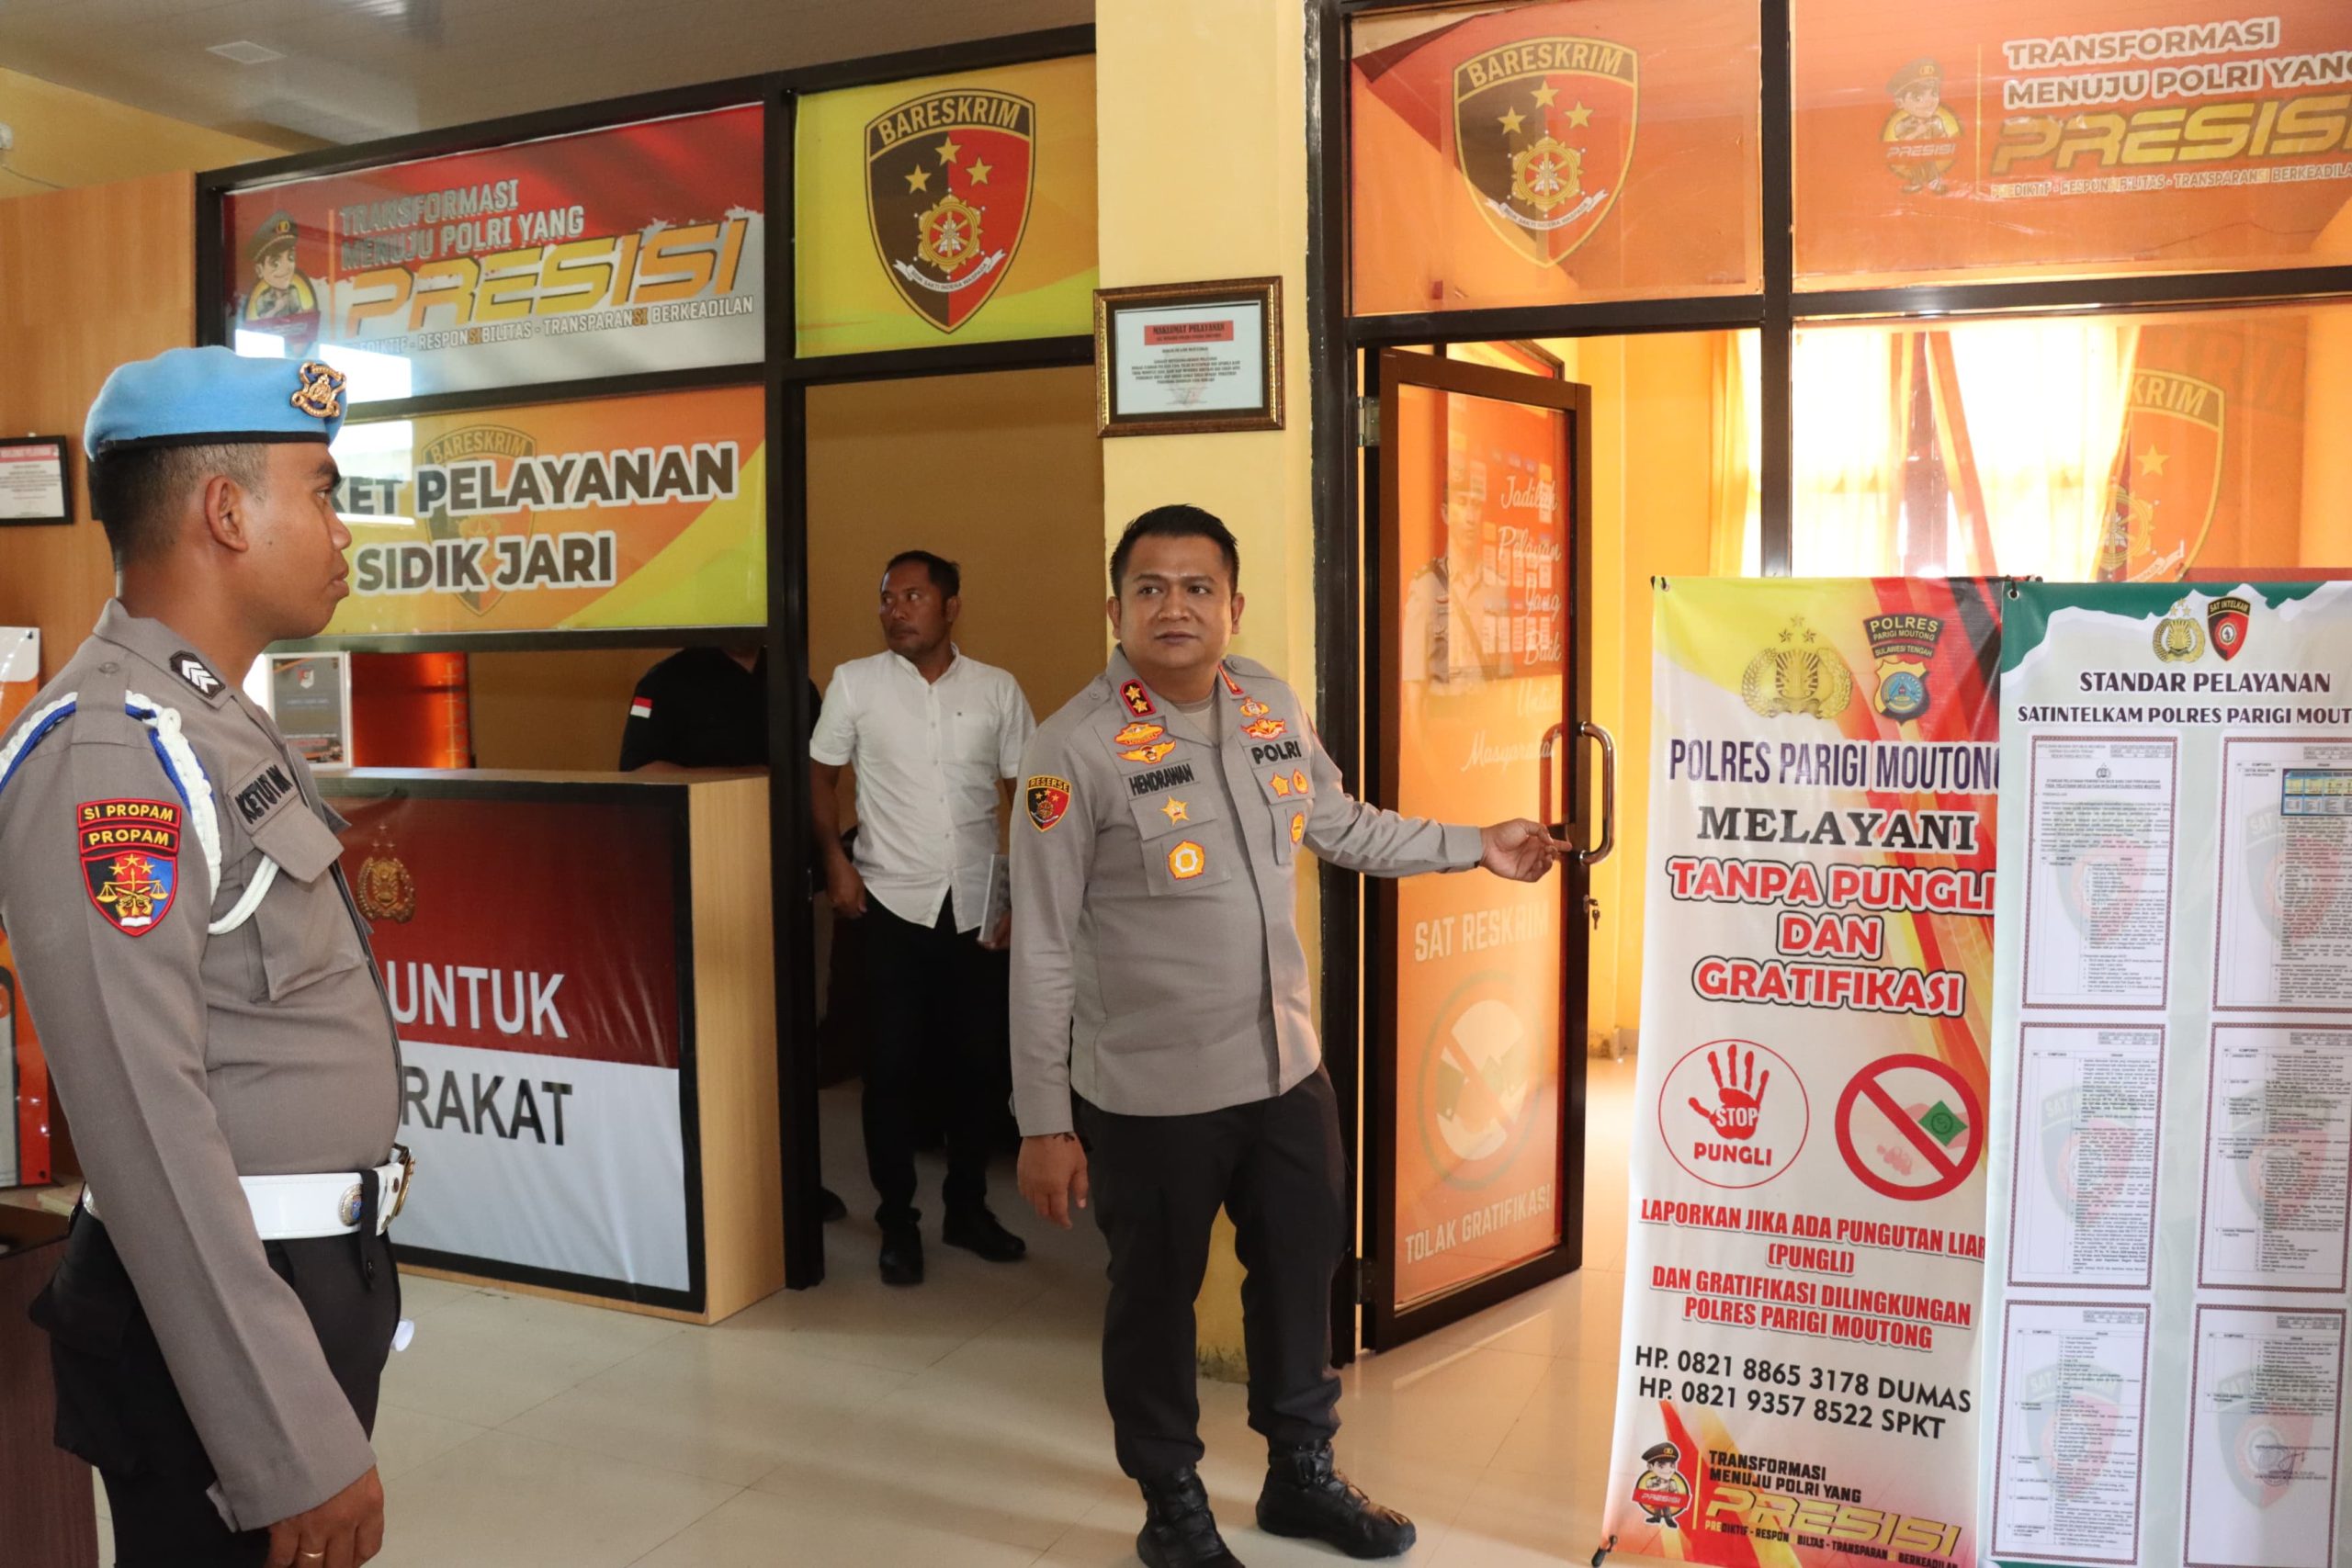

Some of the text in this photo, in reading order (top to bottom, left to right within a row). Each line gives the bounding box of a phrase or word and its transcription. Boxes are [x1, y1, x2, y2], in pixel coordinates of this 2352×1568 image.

[1469, 43, 1623, 89] BARESKRIM
[2007, 21, 2276, 65] TRANSFORMASI
[2008, 55, 2352, 106] MENUJU POLRI YAN
[877, 97, 1020, 145] BARESKRIM
[1886, 143, 1956, 158] PRESISI
[340, 179, 519, 237] TRANSFORMASI
[341, 206, 584, 270] MENUJU POLRI YANG
[345, 217, 751, 338] PRESISI
[418, 321, 532, 351] RESPONSIBILITAS
[544, 307, 649, 336] TRANSPARANSI
[652, 297, 753, 323] BERKEADILAN
[431, 431, 527, 465] BARESKRIM
[416, 446, 735, 514] PELAYANAN
[356, 536, 613, 592] SIDIK JARI
[1870, 616, 1939, 633] POLRES
[1873, 629, 1935, 641] PARIGI MOUTONG
[1875, 645, 1933, 657] SULAWESI TENGAH
[2080, 671, 2331, 693] STANDAR PELAYANAN
[2018, 705, 2143, 723] SATINTELKAM
[2148, 707, 2222, 723] POLRES
[2227, 707, 2291, 724] PARIGI
[1251, 740, 1302, 765] POLRI
[1669, 739, 1999, 791] POLRES PARIGI MOUTON
[1030, 777, 1069, 793] RESERSE
[1128, 763, 1195, 796] HENDRAWAN
[84, 804, 173, 822] SI PROPAM
[1697, 806, 1975, 851] MELAYANI
[88, 829, 169, 847] PROPAM
[1670, 861, 1996, 911] TANPA PUNGLI
[1414, 899, 1549, 963] SAT RESKRIM
[1781, 916, 1879, 955] DAN
[386, 960, 570, 1040] UNTUK
[1698, 961, 1961, 1012] GRATIFIKASI
[402, 1065, 573, 1146] RAKAT
[1715, 1106, 1759, 1128] STOP
[1693, 1142, 1772, 1167] PUNGLI
[1405, 1182, 1551, 1265] TOLAK GRATIFIKASI
[1640, 1199, 1986, 1260] LAPORKAN JIKA ADA PUNGUTAN LIAR
[1768, 1243, 1855, 1274] (PUNGLI)
[1652, 1265, 1971, 1326] DAN GRATIFIKASI DILINGKUNGAN
[1684, 1297, 1933, 1349] POLRES PARIGI MOUTONG
[1635, 1345, 1972, 1414] HP. 0821 8865 3178 DUMAS
[1639, 1377, 1946, 1439] HP. 0821 9357 8522 SPKT
[1709, 1450, 1826, 1482] TRANSFORMASI
[1709, 1468, 1862, 1504] MENUJU POLRI YANG
[1705, 1486, 1962, 1558] PRESISI
[1705, 1519, 1749, 1536] PREDIKTIF
